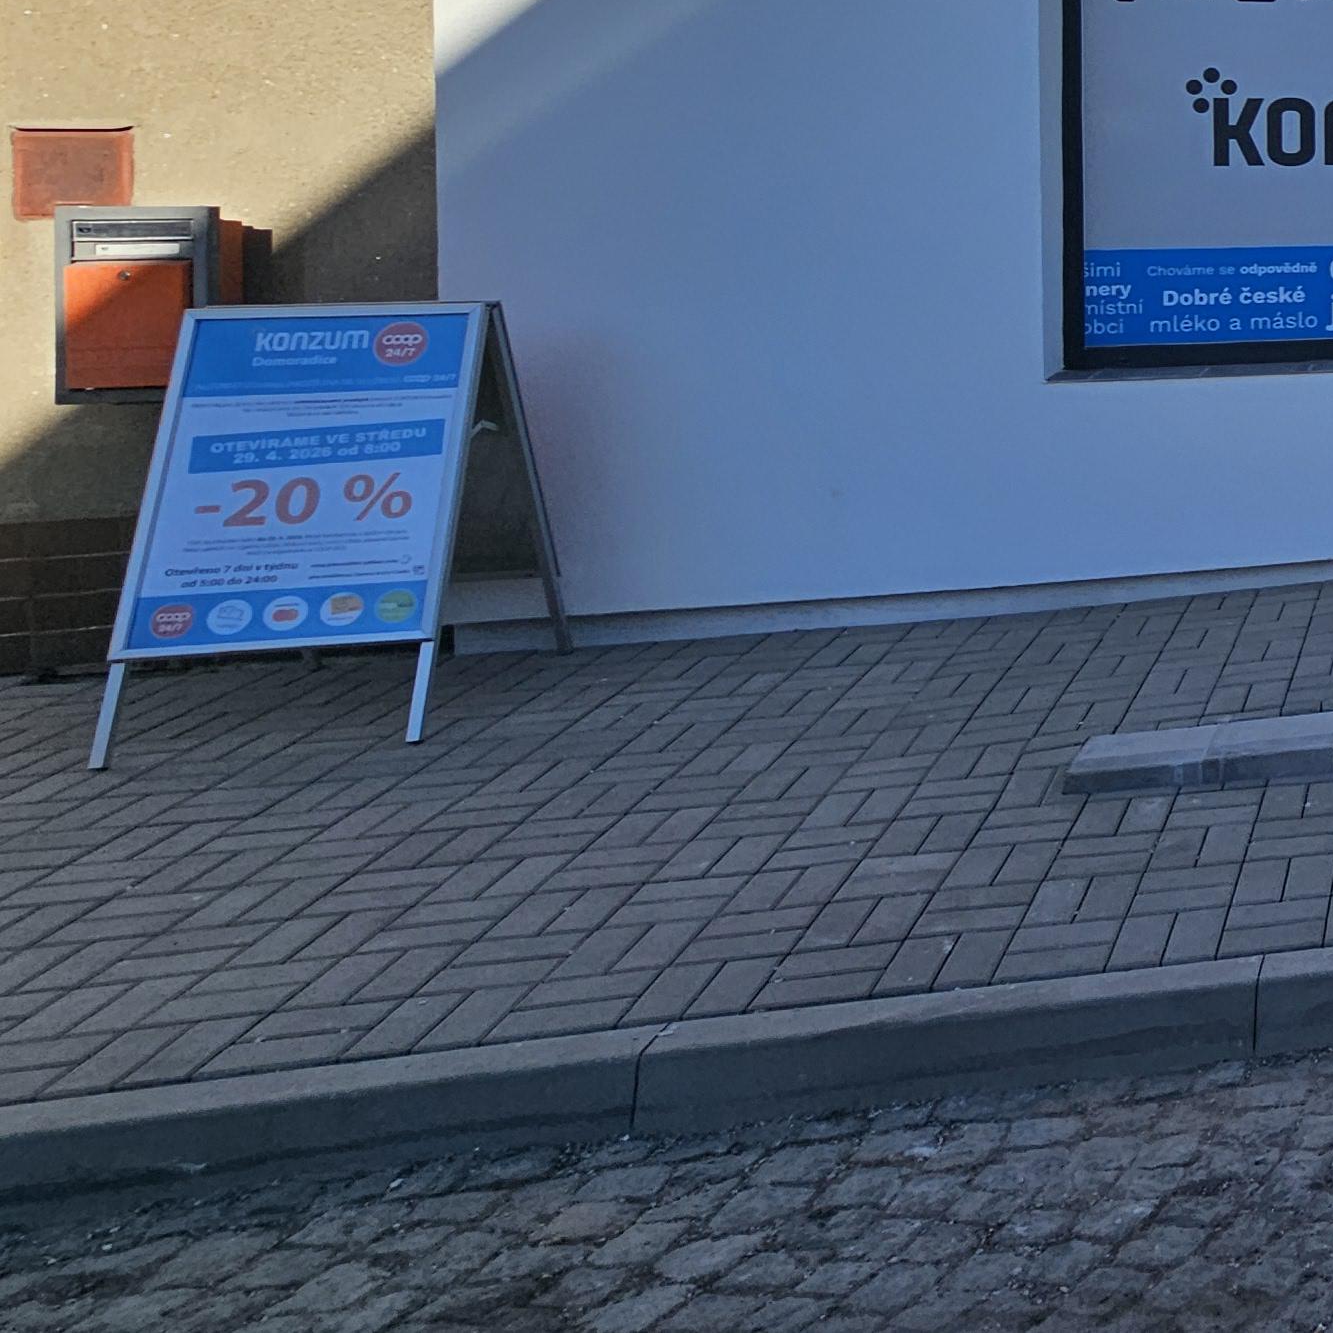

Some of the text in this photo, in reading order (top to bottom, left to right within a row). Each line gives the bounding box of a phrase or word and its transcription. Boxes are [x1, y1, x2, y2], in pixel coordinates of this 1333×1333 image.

[1147, 262, 1318, 277] Chováme se odpovědně
[1162, 286, 1307, 307] Dobré české
[1150, 311, 1318, 333] mléko a máslo
[385, 347, 416, 358] 24/7
[326, 432, 350, 444] VE
[355, 426, 427, 443] STŘEDU
[233, 452, 260, 465] 29.
[265, 450, 282, 462] 4.
[290, 447, 333, 461] 2026
[337, 445, 359, 456] od
[194, 472, 413, 528] -20 %
[164, 565, 222, 577] Otevřeno
[224, 565, 231, 573] 7
[181, 578, 197, 588] od
[227, 576, 243, 586] do
[245, 574, 278, 586] 24:00
